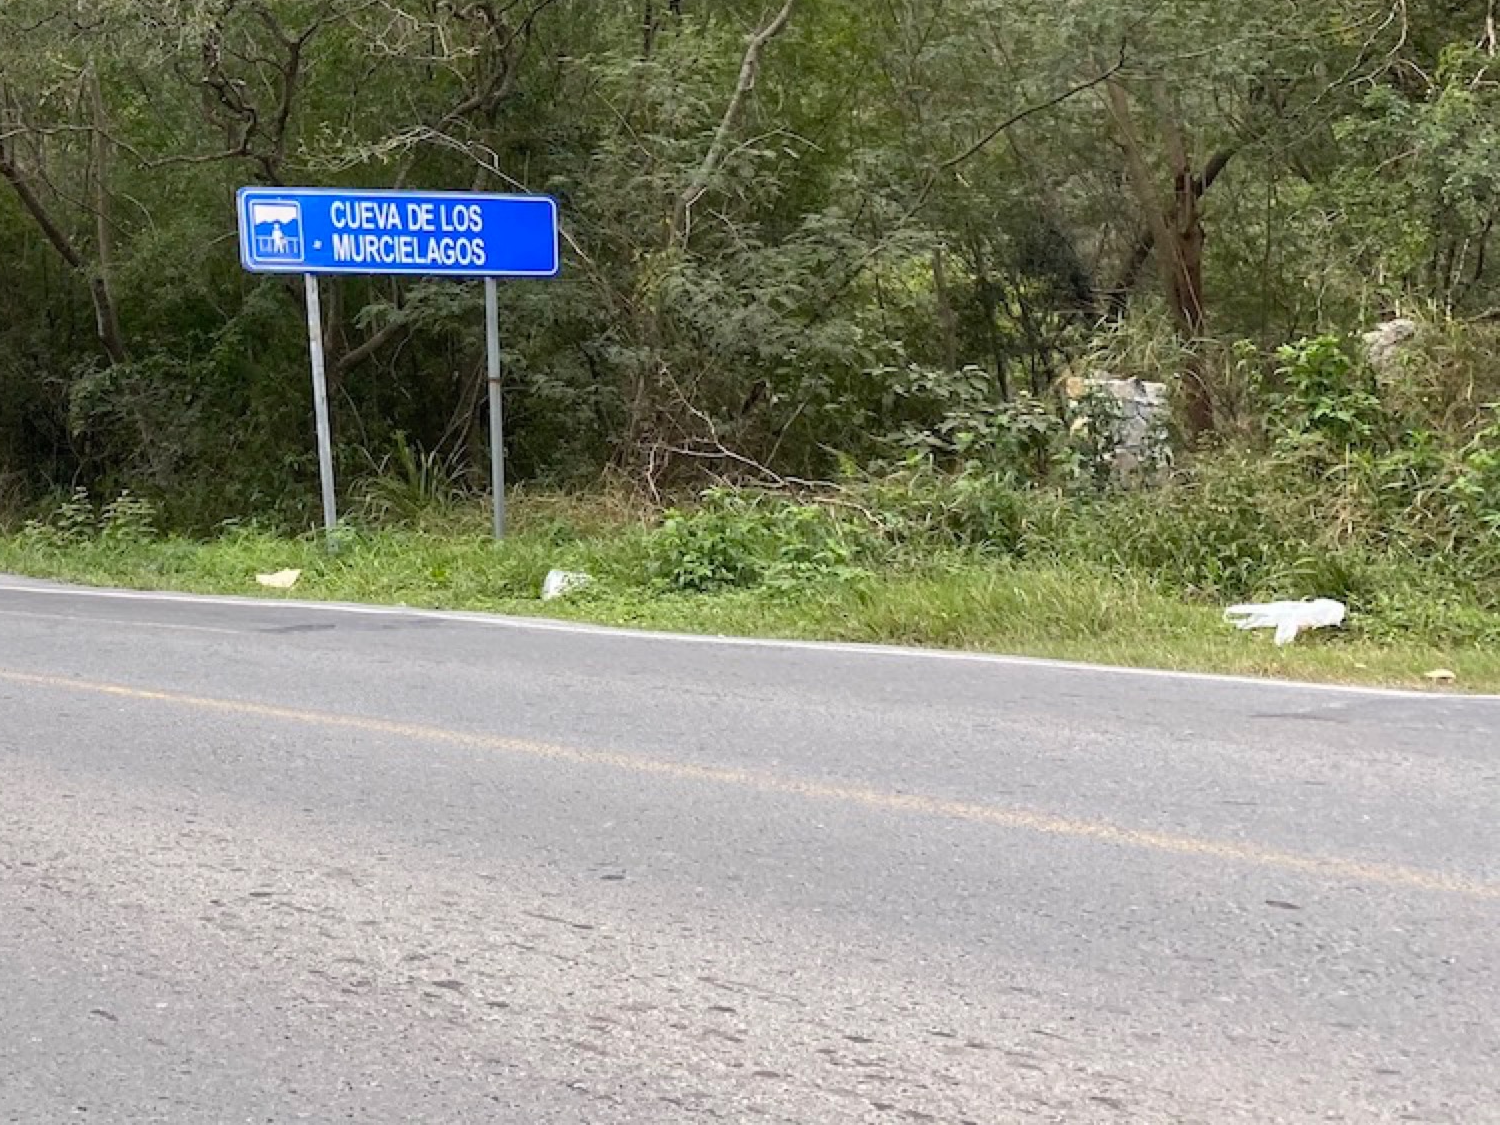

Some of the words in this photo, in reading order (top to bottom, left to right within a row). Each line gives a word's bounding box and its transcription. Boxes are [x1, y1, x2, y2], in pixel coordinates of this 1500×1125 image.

[330, 201, 401, 230] CUEVA
[407, 204, 434, 231] DE
[440, 204, 483, 232] LOS
[332, 233, 486, 266] MURCIELAGOS
